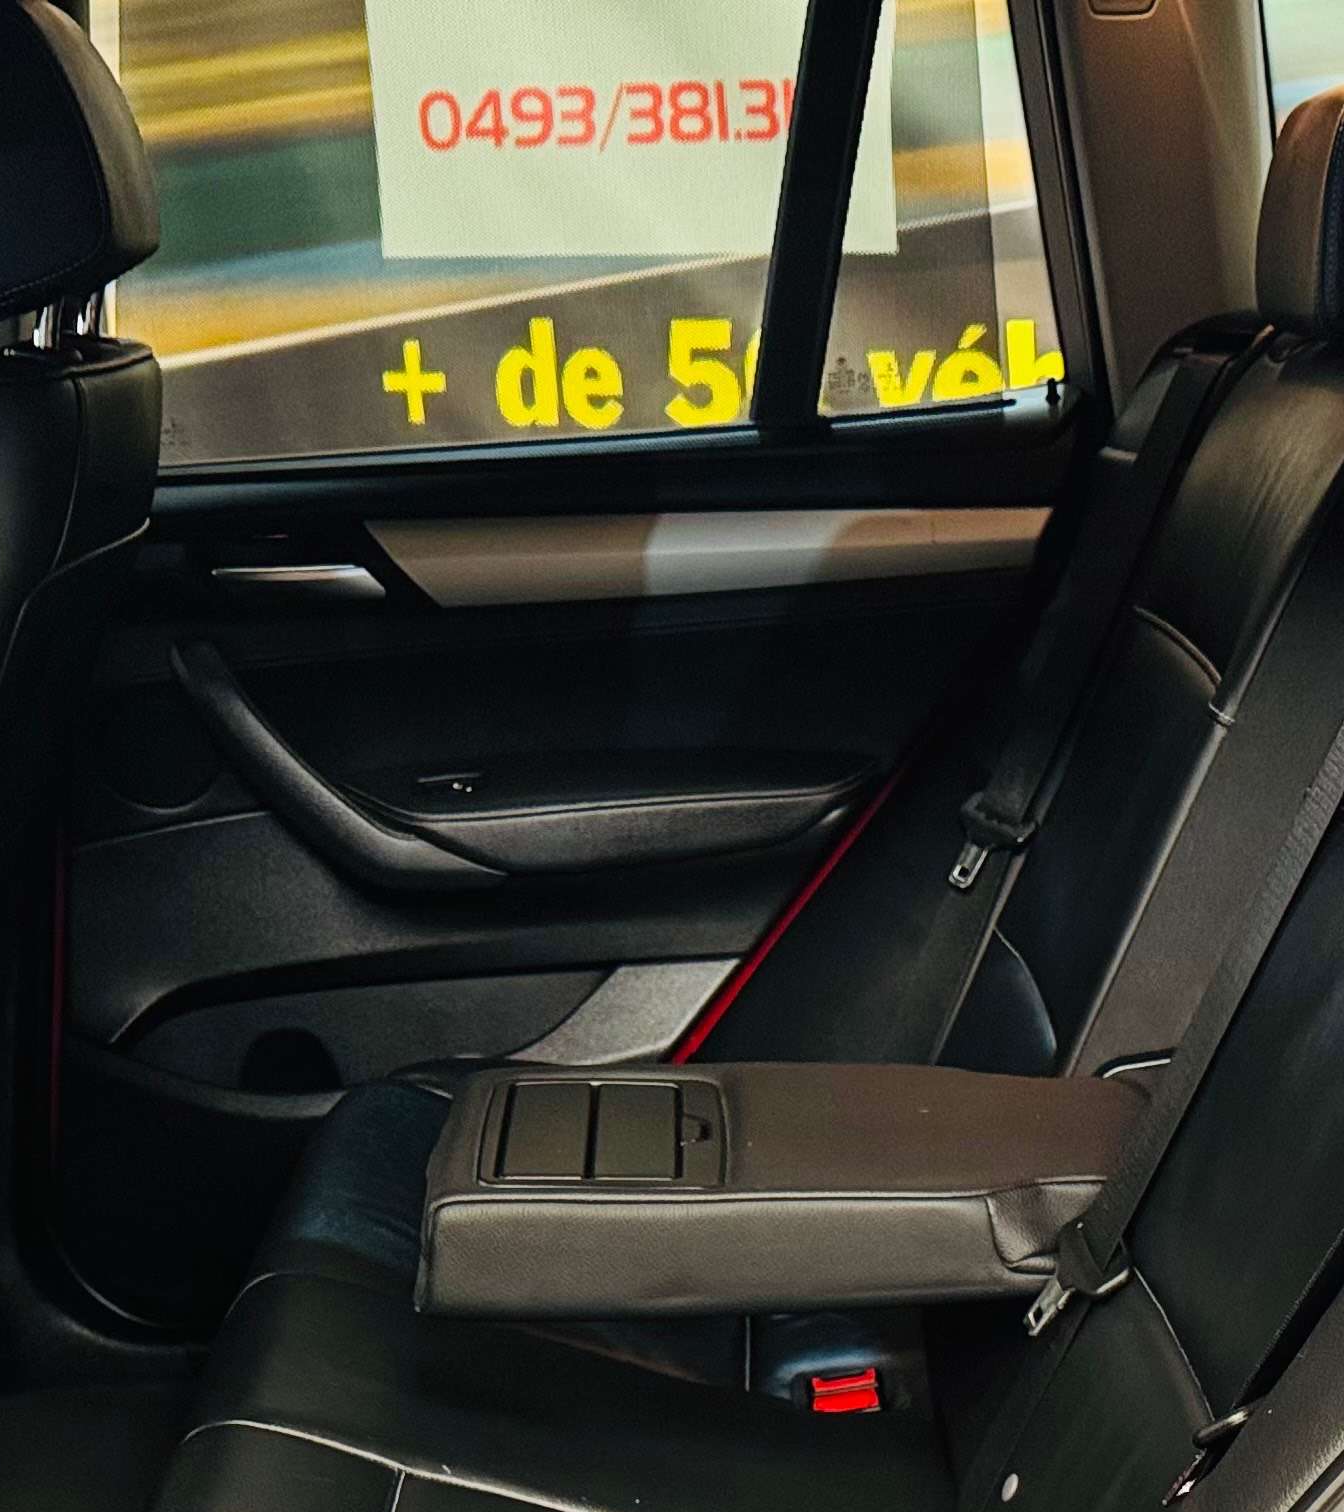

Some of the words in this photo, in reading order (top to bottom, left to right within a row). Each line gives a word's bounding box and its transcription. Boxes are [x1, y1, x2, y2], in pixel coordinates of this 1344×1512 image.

[418, 79, 795, 153] 0493/381.31
[495, 317, 625, 431] de
[664, 317, 762, 428] 5
